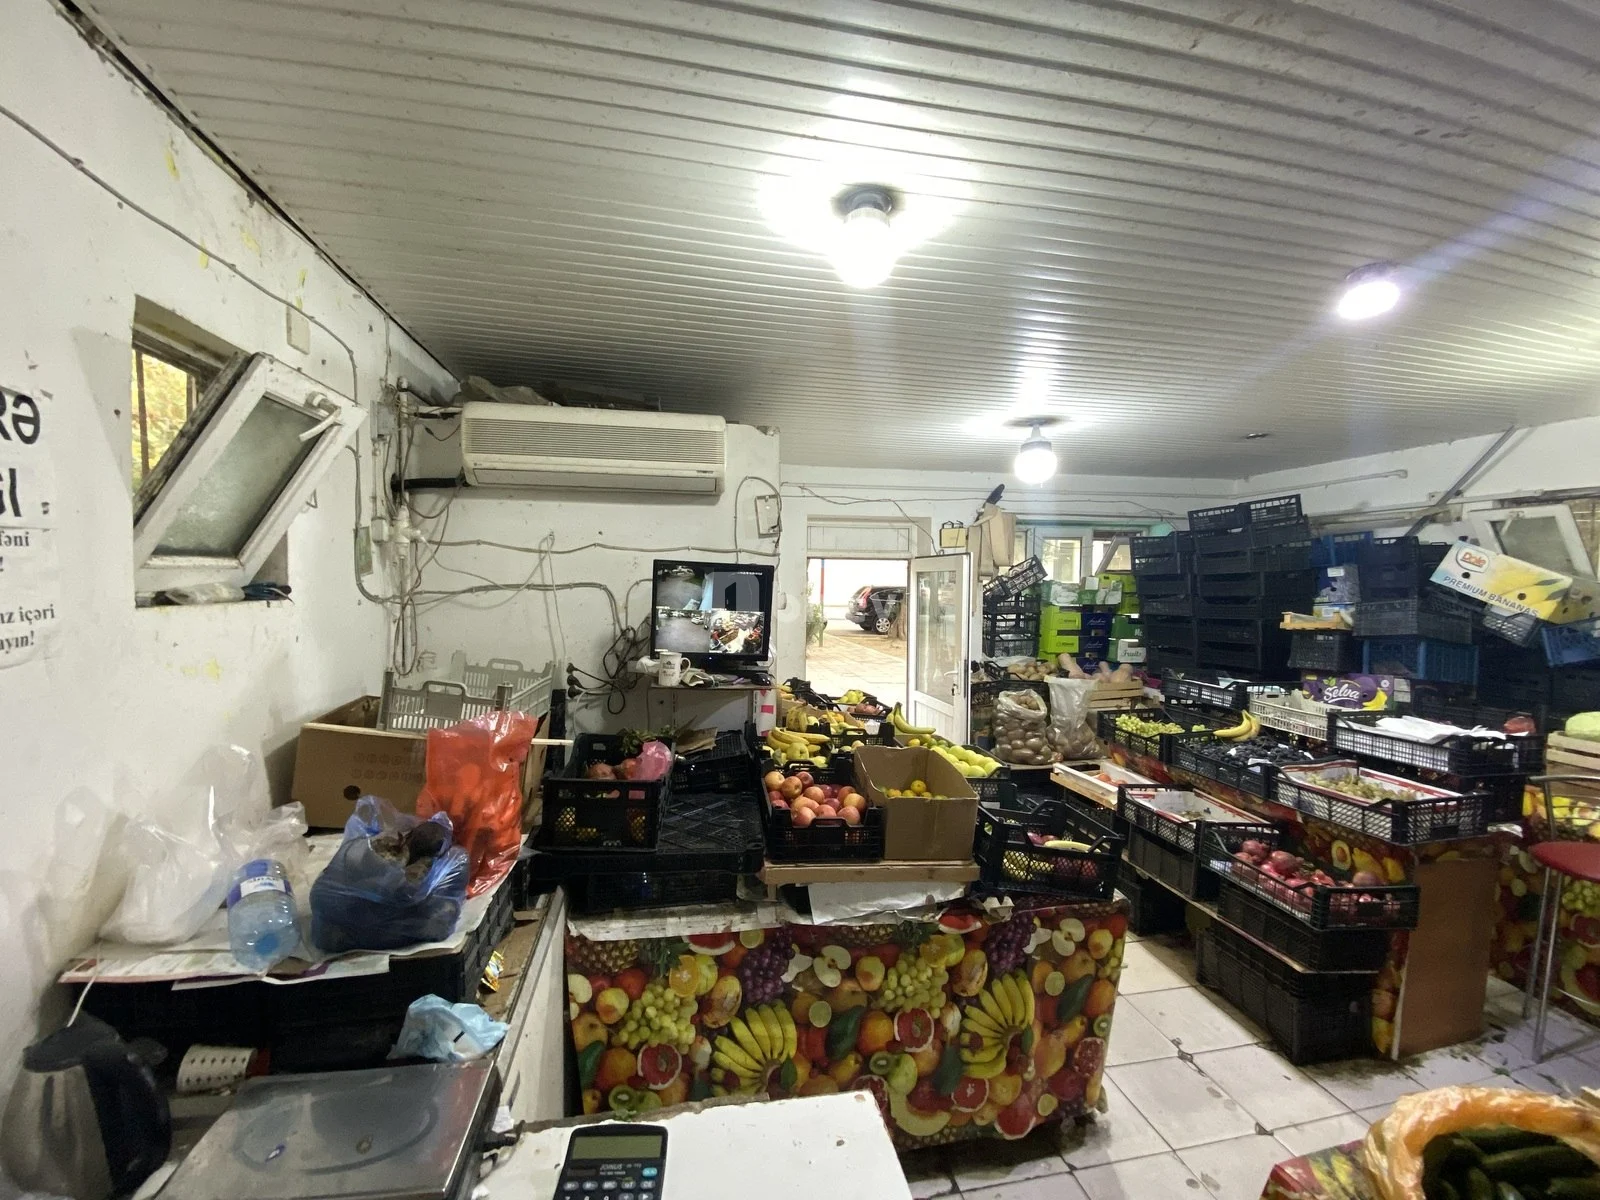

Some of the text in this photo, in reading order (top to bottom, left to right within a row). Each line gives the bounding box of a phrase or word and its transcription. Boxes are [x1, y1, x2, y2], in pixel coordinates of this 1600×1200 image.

[1461, 552, 1486, 567] Dole
[1443, 576, 1538, 616] PREMIUM BANANAS
[19, 603, 55, 626] içəri
[1323, 683, 1360, 701] Selva
